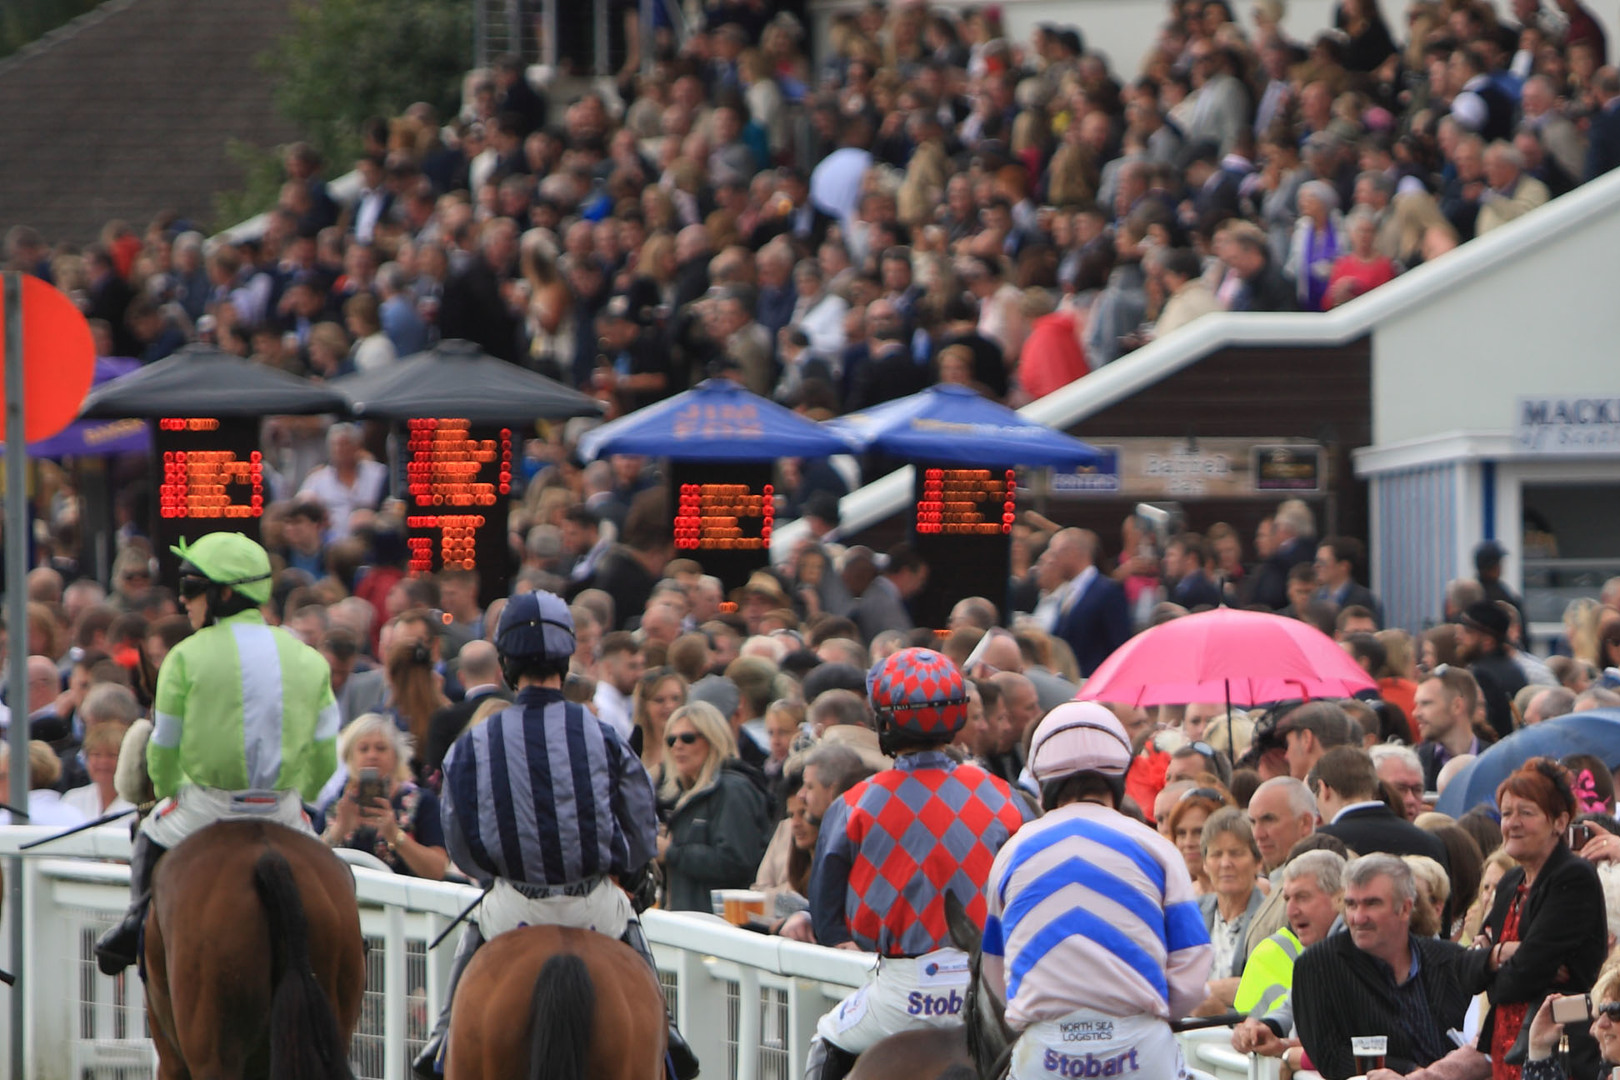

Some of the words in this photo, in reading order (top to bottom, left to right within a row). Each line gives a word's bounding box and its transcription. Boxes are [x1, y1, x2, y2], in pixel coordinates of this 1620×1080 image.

[907, 989, 964, 1016] Stob
[1060, 1021, 1093, 1033] NORTH
[1095, 1021, 1114, 1031] SEA
[1062, 1031, 1113, 1042] LOGISTICS
[1043, 1046, 1140, 1078] Stobart
